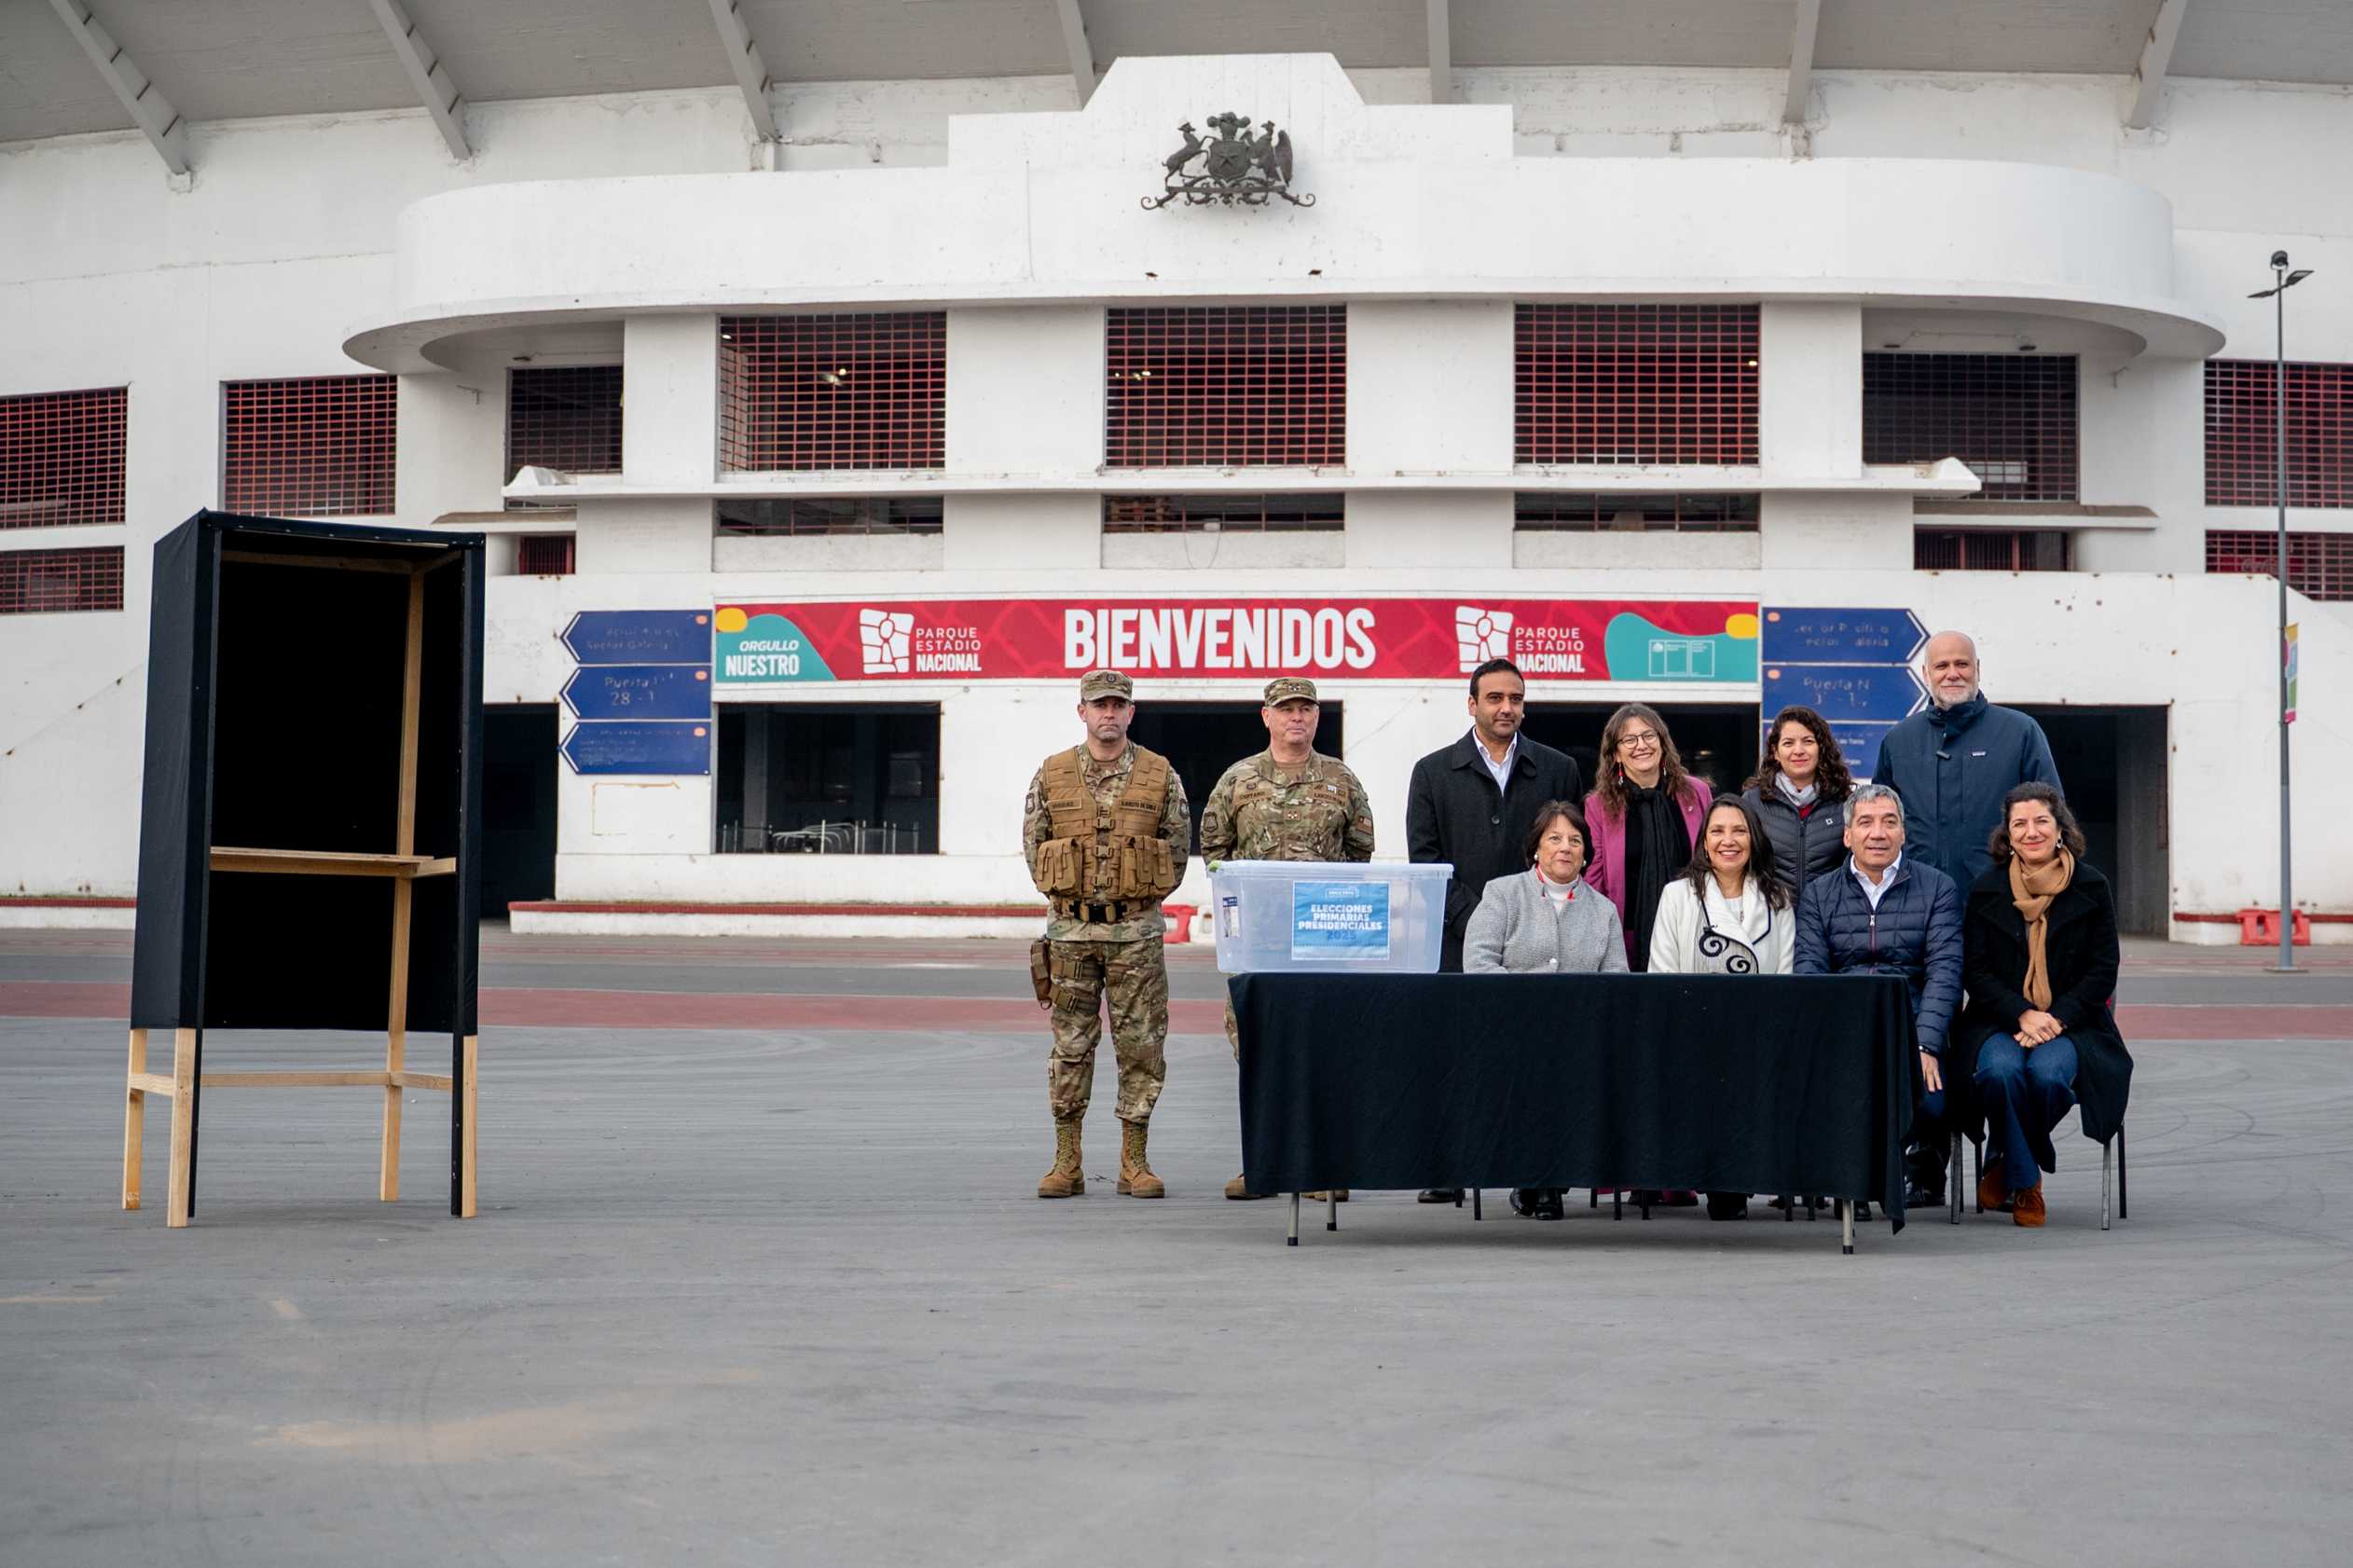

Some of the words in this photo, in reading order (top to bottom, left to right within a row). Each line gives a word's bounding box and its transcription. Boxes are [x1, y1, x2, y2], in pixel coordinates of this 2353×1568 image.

[915, 627, 977, 640] PARQUE
[1065, 608, 1376, 669] BIENVENIDOS
[1515, 627, 1580, 640] PARQUE
[739, 640, 799, 652] ORGULLO
[915, 640, 982, 652] ESTADIO
[1515, 640, 1585, 651] ESTADIO
[725, 654, 800, 677] NUESTRO
[915, 653, 982, 672] NACIONAL
[1515, 653, 1586, 673] NACIONAL
[1311, 904, 1373, 913] ELECCIONES
[1314, 913, 1369, 921] PRIMARIAS
[1298, 921, 1383, 930] PRESIDENCIALES
[1327, 931, 1356, 940] 2025
